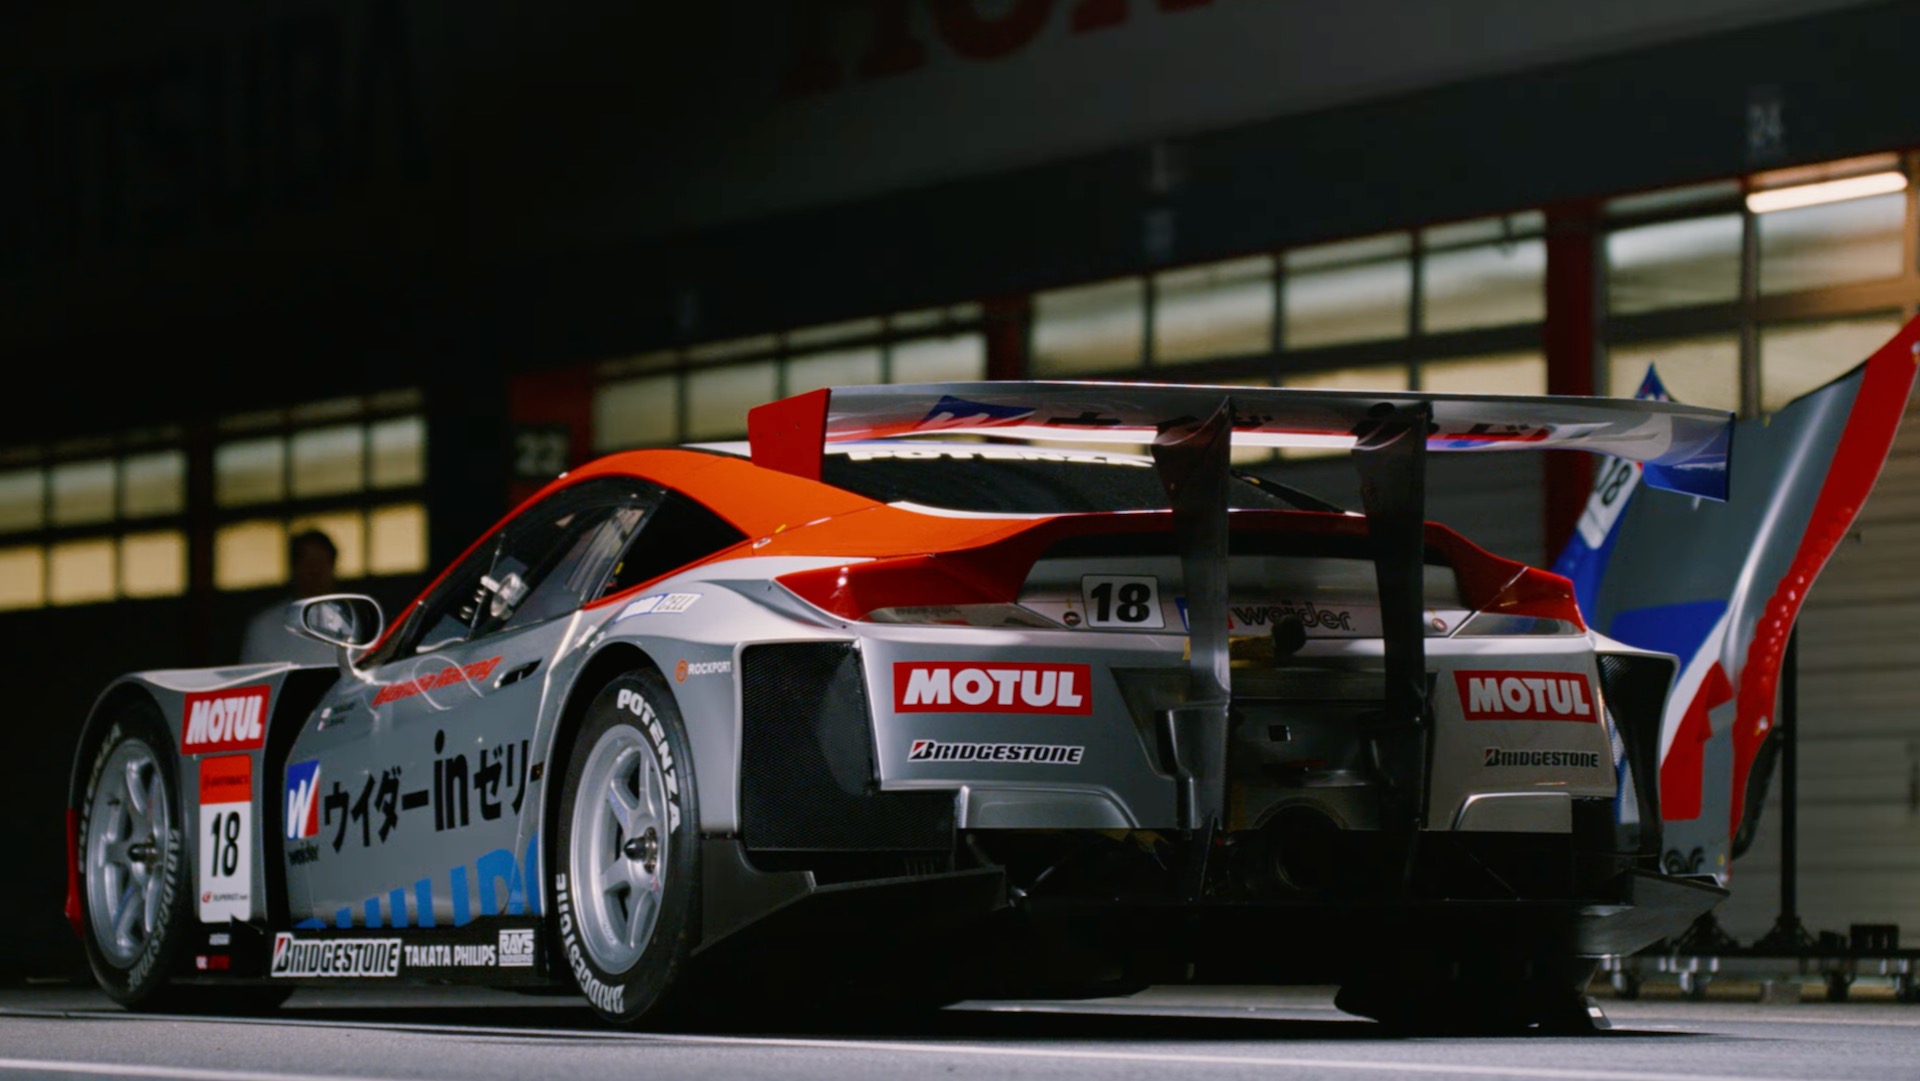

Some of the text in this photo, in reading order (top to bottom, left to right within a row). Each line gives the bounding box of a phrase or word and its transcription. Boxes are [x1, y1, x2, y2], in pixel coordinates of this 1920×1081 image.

[1090, 582, 1150, 623] 18
[688, 661, 731, 675] ROCKPORT
[903, 668, 1083, 707] MOTUL
[1469, 677, 1590, 715] MOTUL
[184, 694, 263, 745] MOTUL
[616, 689, 681, 834] POTENZA
[909, 741, 1084, 764] BRIDGESTONE
[1485, 748, 1599, 768] BRIDGESTONE
[211, 811, 241, 877] 18
[273, 934, 401, 975] BRIDGESTONE
[404, 945, 497, 966] TAKATA PHILIPS
[499, 932, 534, 955] RAYS
[556, 873, 625, 1014] BRIDGESTONE
